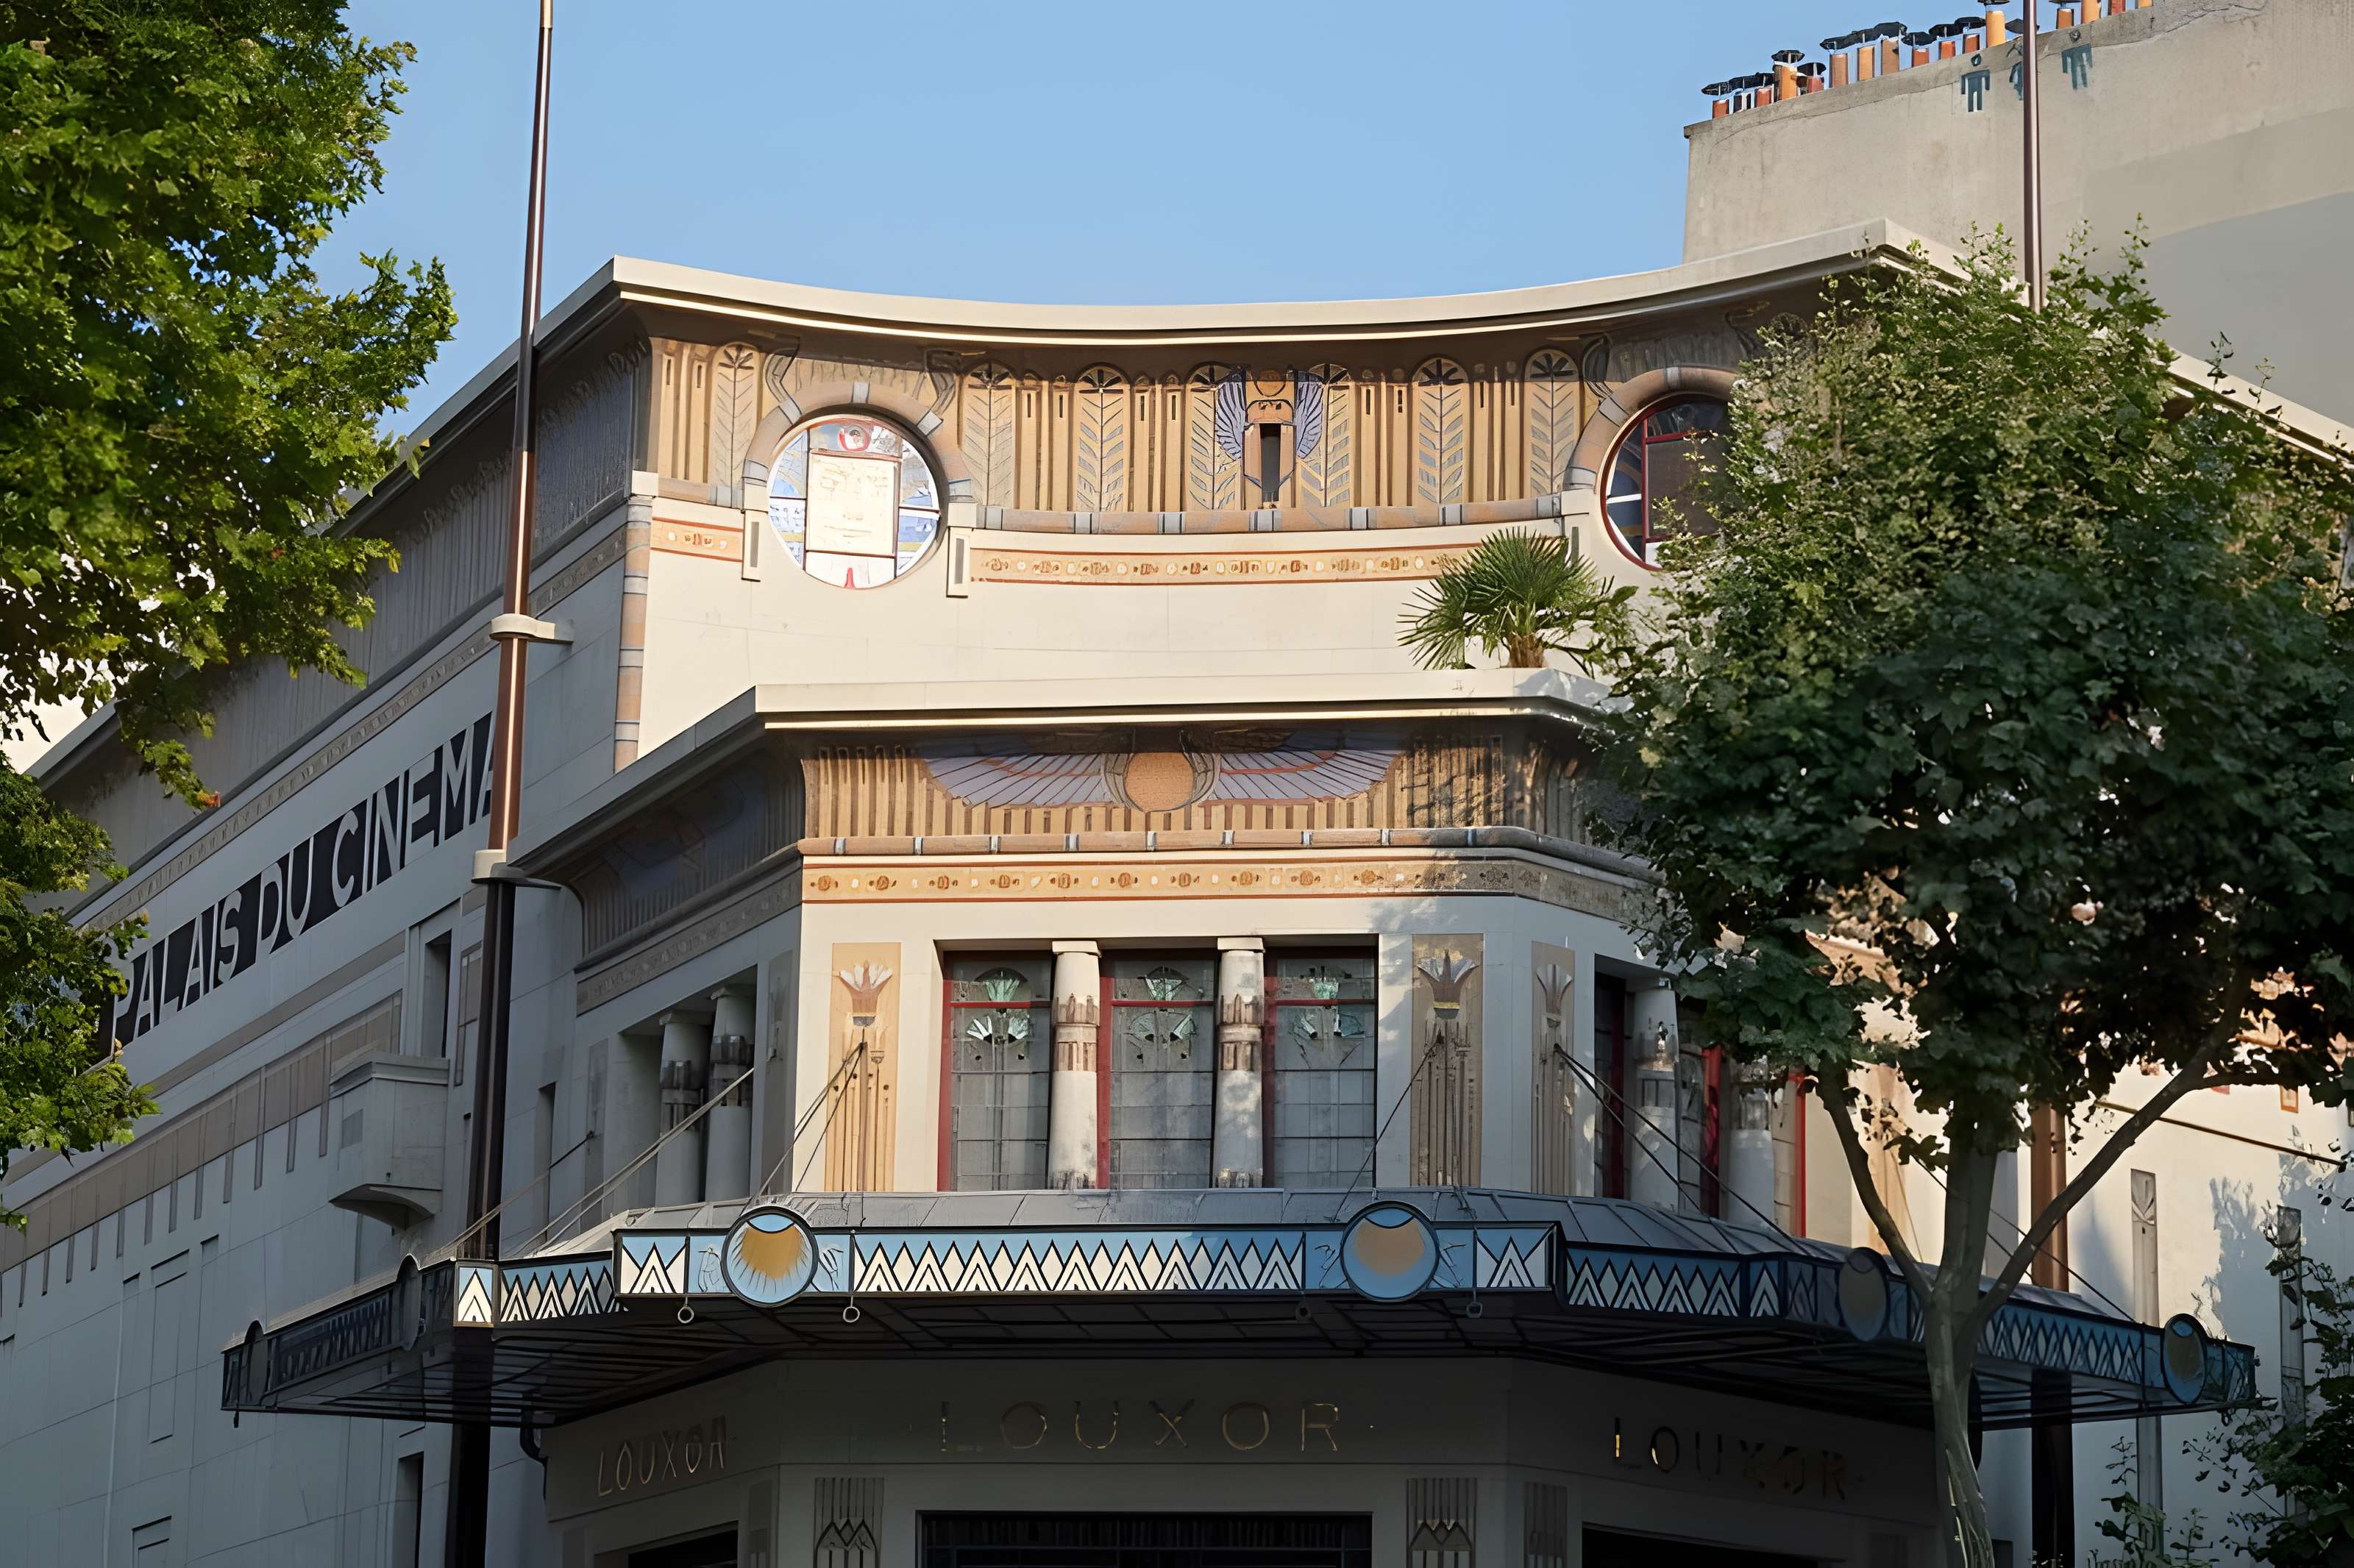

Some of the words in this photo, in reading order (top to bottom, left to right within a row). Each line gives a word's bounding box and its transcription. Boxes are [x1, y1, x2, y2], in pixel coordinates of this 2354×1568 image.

[110, 891, 241, 1060] PALAIS
[255, 836, 314, 963] DU
[941, 1399, 1340, 1452] LOUXOR
[1613, 1417, 1846, 1501] LOUXOR
